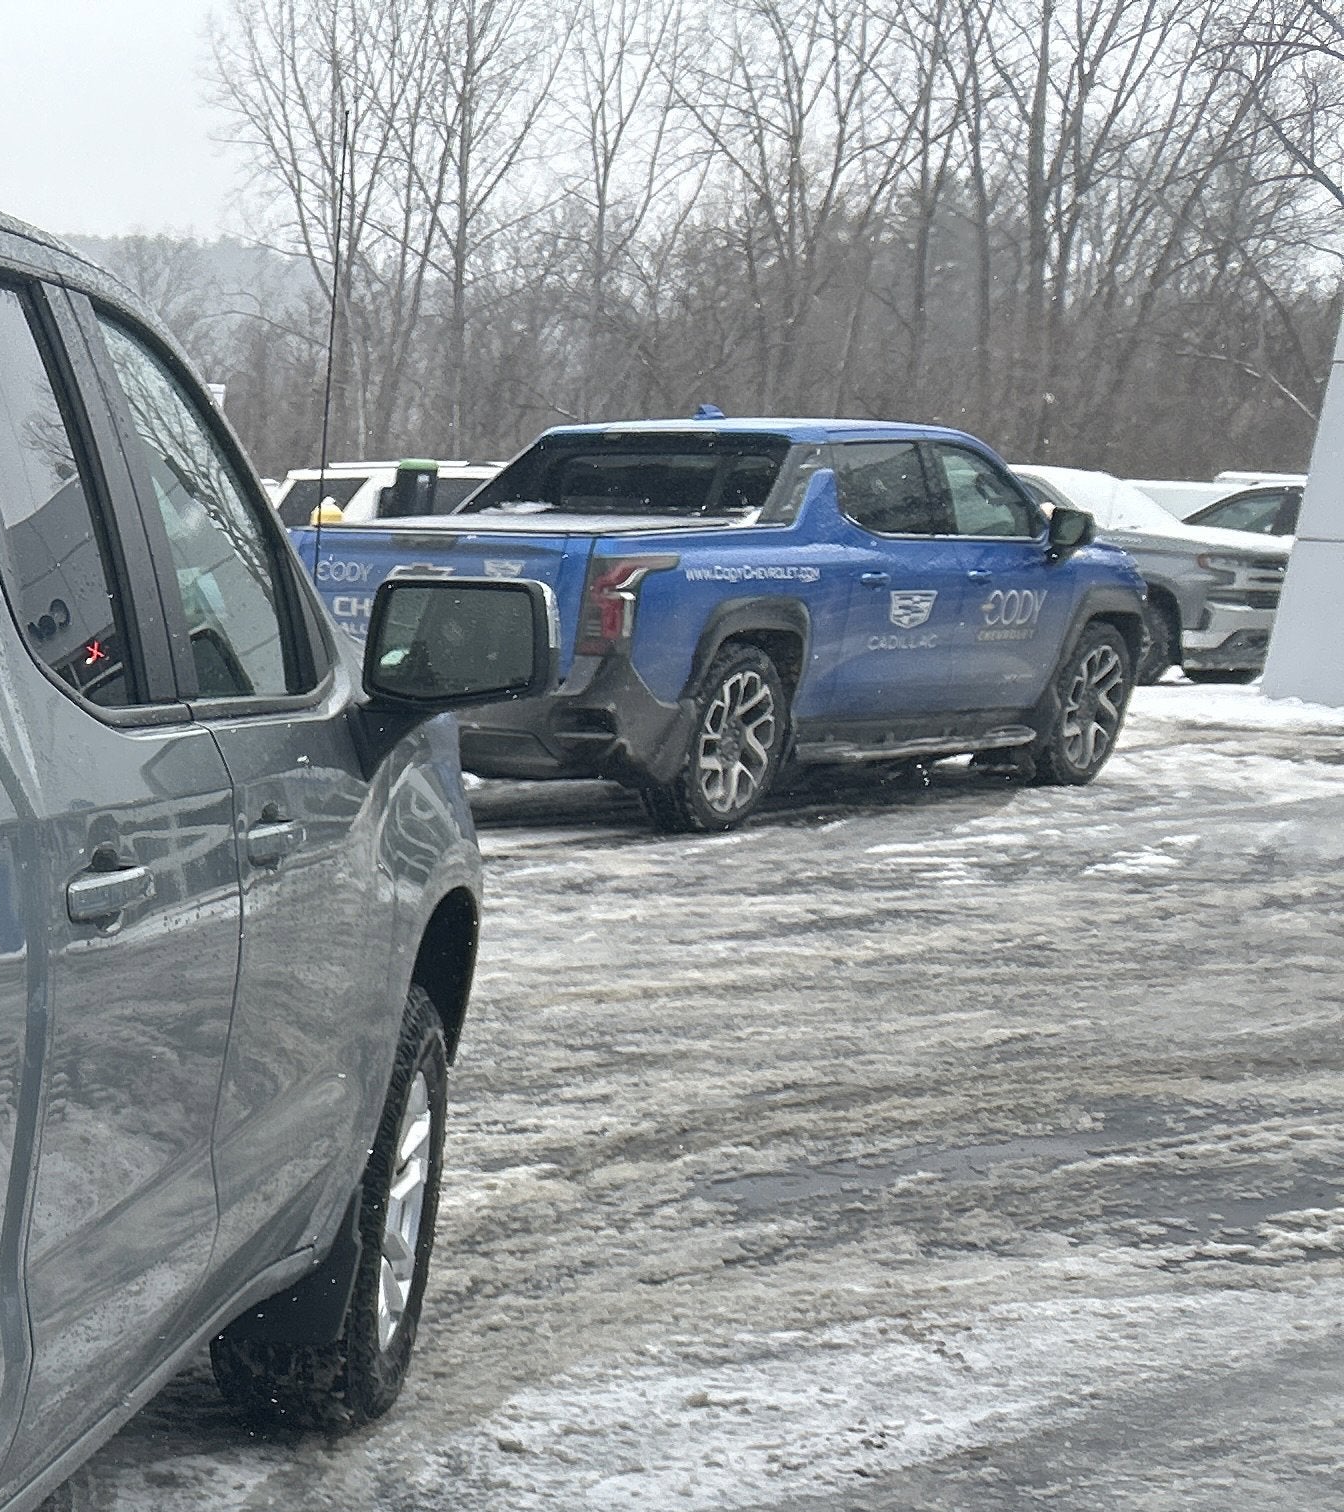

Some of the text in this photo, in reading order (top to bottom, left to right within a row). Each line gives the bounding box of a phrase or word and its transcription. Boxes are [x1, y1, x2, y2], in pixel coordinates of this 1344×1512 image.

[333, 596, 374, 618] CH
[981, 589, 1048, 626] CODY
[867, 634, 939, 651] CADILLAC
